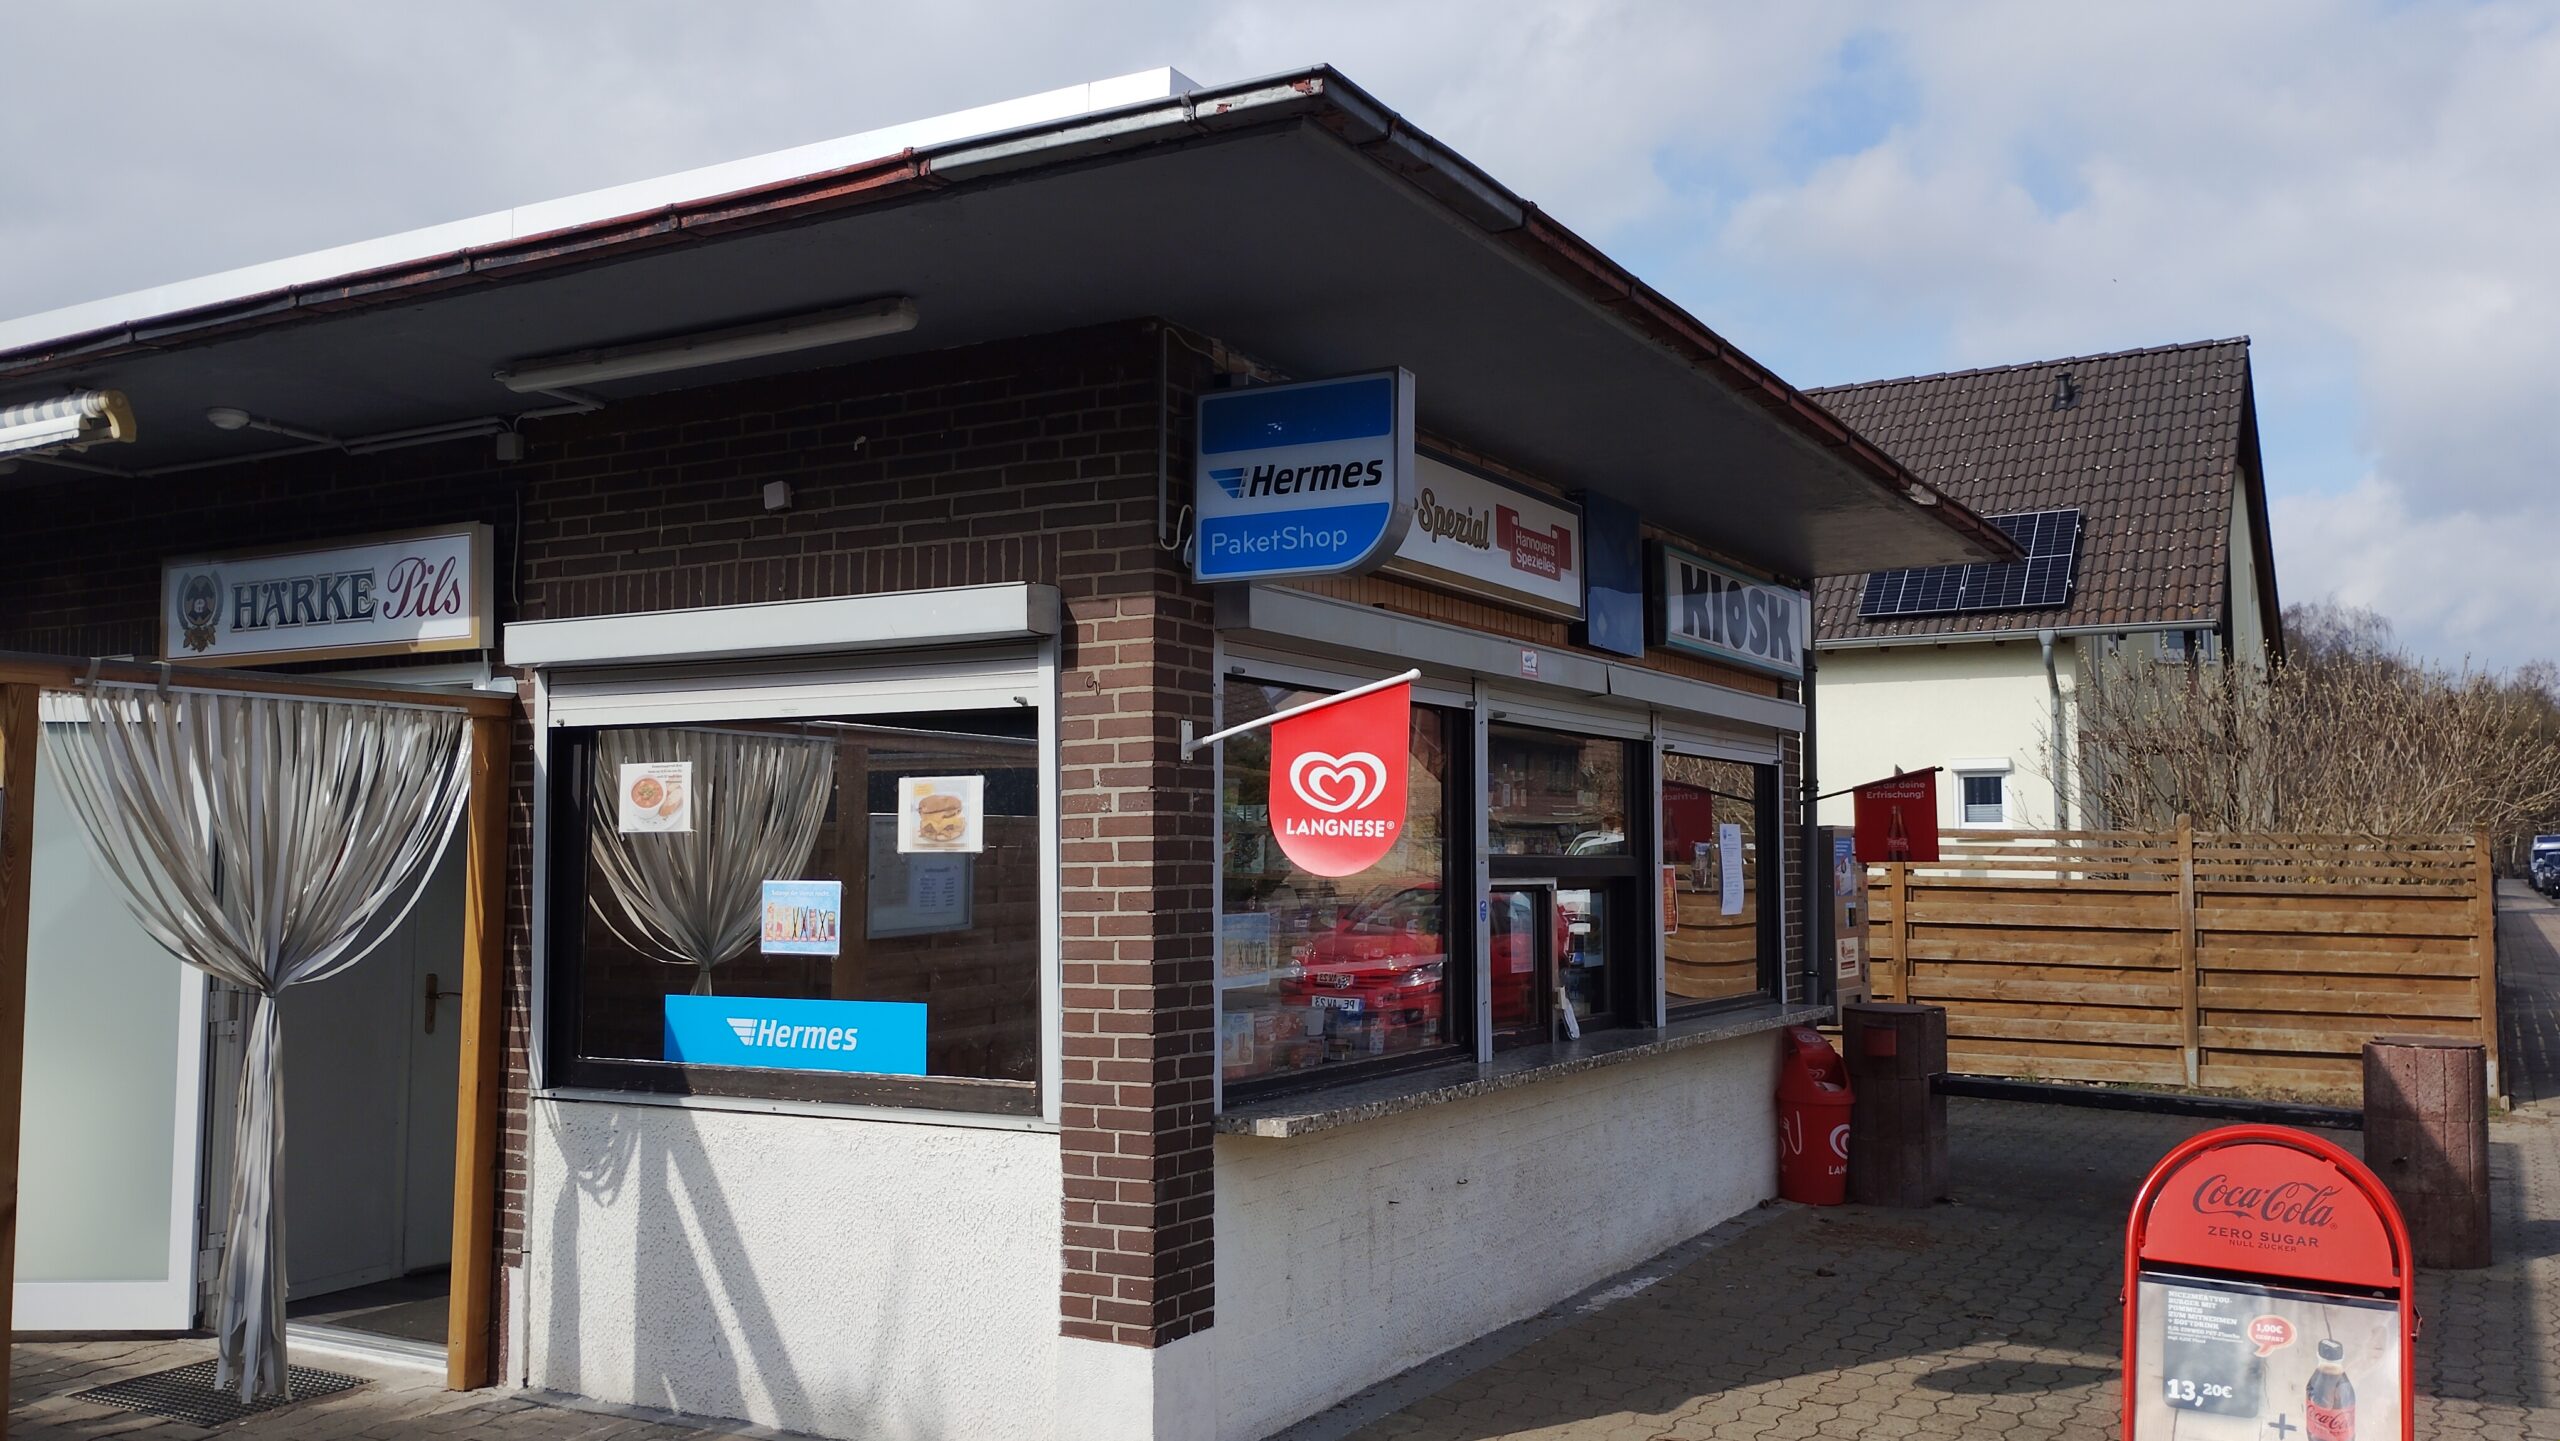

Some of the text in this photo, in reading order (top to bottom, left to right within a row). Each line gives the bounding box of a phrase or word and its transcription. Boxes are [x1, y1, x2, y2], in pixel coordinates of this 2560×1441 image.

[1249, 459, 1384, 498] Hermes
[1418, 487, 1490, 551] Spezial
[1211, 526, 1348, 556] PaketShop
[1515, 529, 1556, 557] Hannovers
[1516, 550, 1556, 575] Spezielles
[230, 556, 461, 632] HÄRKE Pils
[1680, 562, 1793, 663] KIOSK
[1866, 790, 1925, 800] Erfrischung!
[1898, 781, 1926, 789] deine
[756, 1018, 859, 1051] Hermes
[2192, 1173, 2344, 1228] Coca-Cola
[2207, 1225, 2319, 1248] ZERO SUGAR
[2229, 1239, 2297, 1253] NULL ZUCKER
[2168, 1297, 2217, 1309] BURGER MIT
[2168, 1304, 2203, 1314] POMMES
[2256, 1323, 2284, 1335] 1,00€
